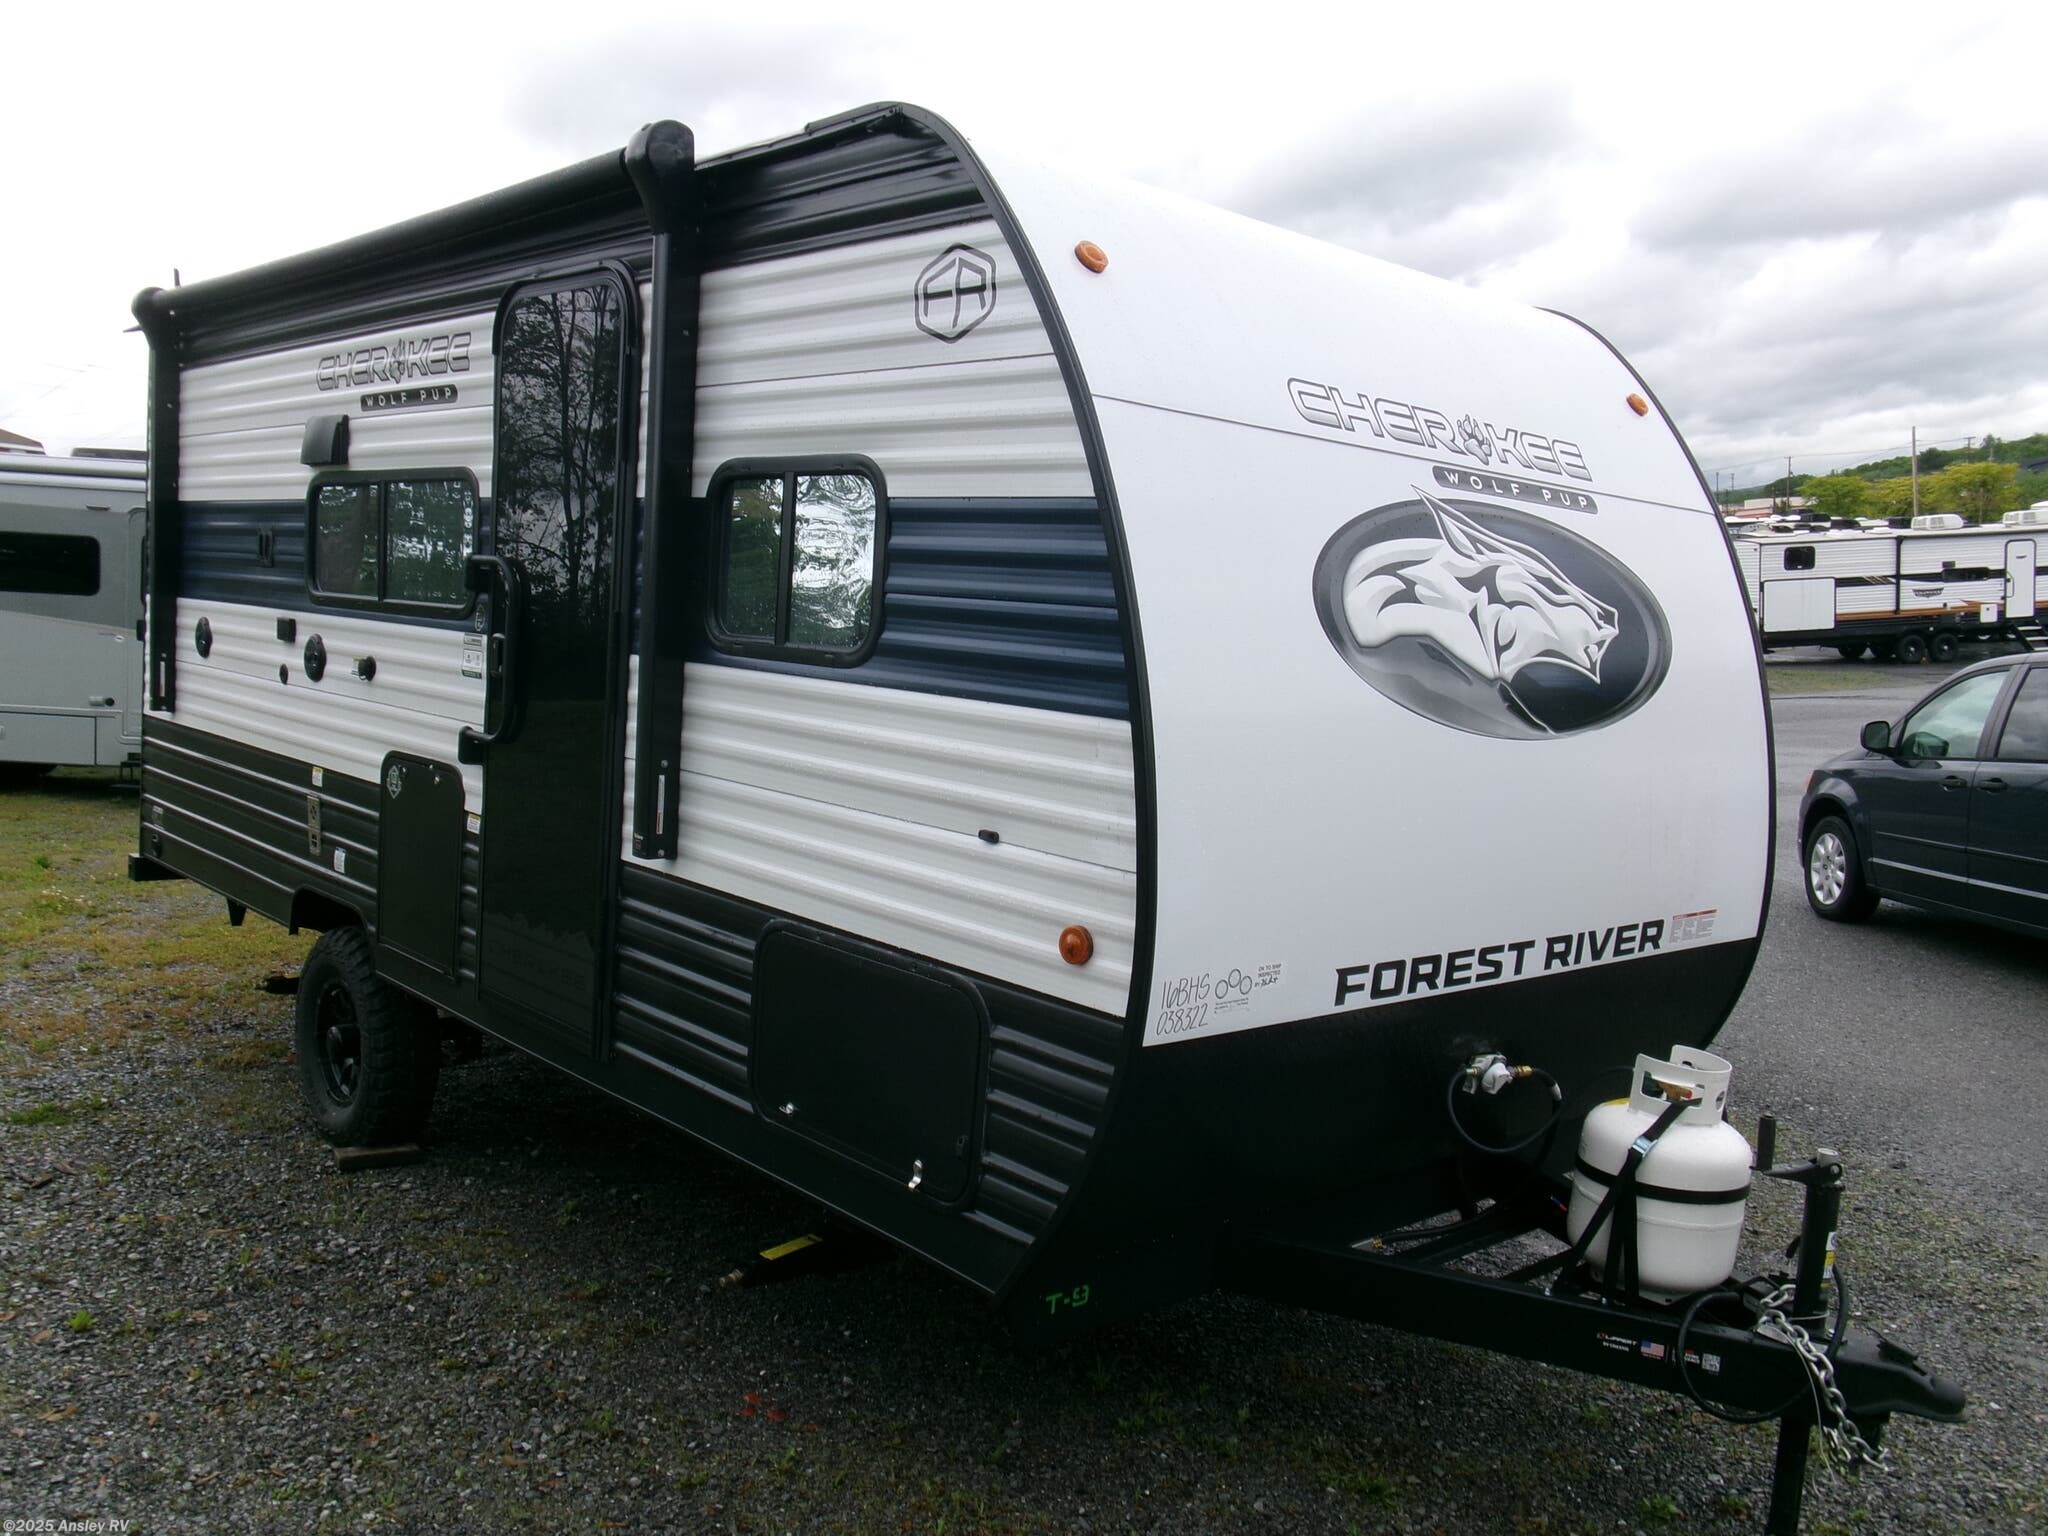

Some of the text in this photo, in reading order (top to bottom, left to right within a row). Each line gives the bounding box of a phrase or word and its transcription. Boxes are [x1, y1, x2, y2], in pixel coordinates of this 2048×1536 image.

[365, 387, 451, 407] WOLF PUP
[1442, 469, 1589, 509] WOLF PUP
[1334, 939, 1536, 1007] FOREST
[1543, 918, 1665, 971] RIVER
[1161, 972, 1211, 1010] 16BHS
[1156, 1002, 1209, 1036] 038322
